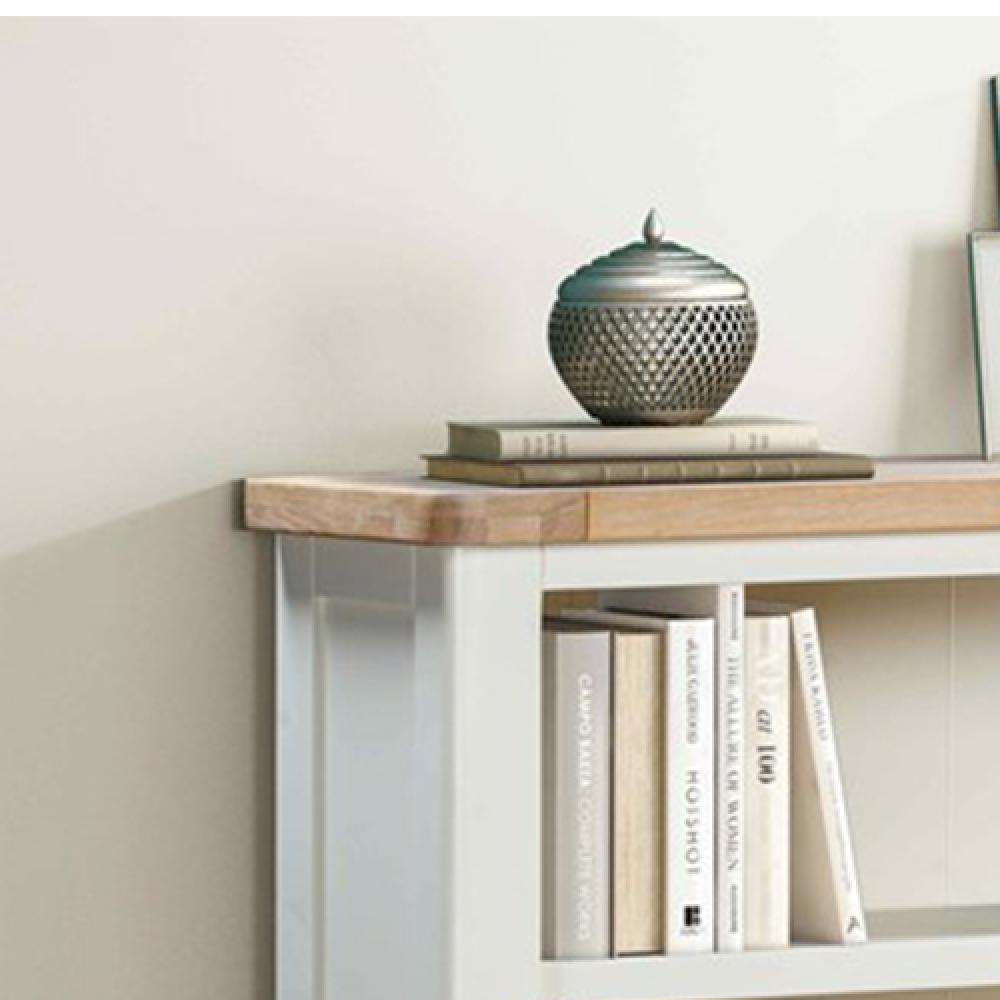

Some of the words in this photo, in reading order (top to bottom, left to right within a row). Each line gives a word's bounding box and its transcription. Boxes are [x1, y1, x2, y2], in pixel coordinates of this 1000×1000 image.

[727, 656, 739, 691] THE
[727, 770, 739, 792] OF
[757, 744, 776, 785] 100
[685, 771, 701, 876] HOTSHOT
